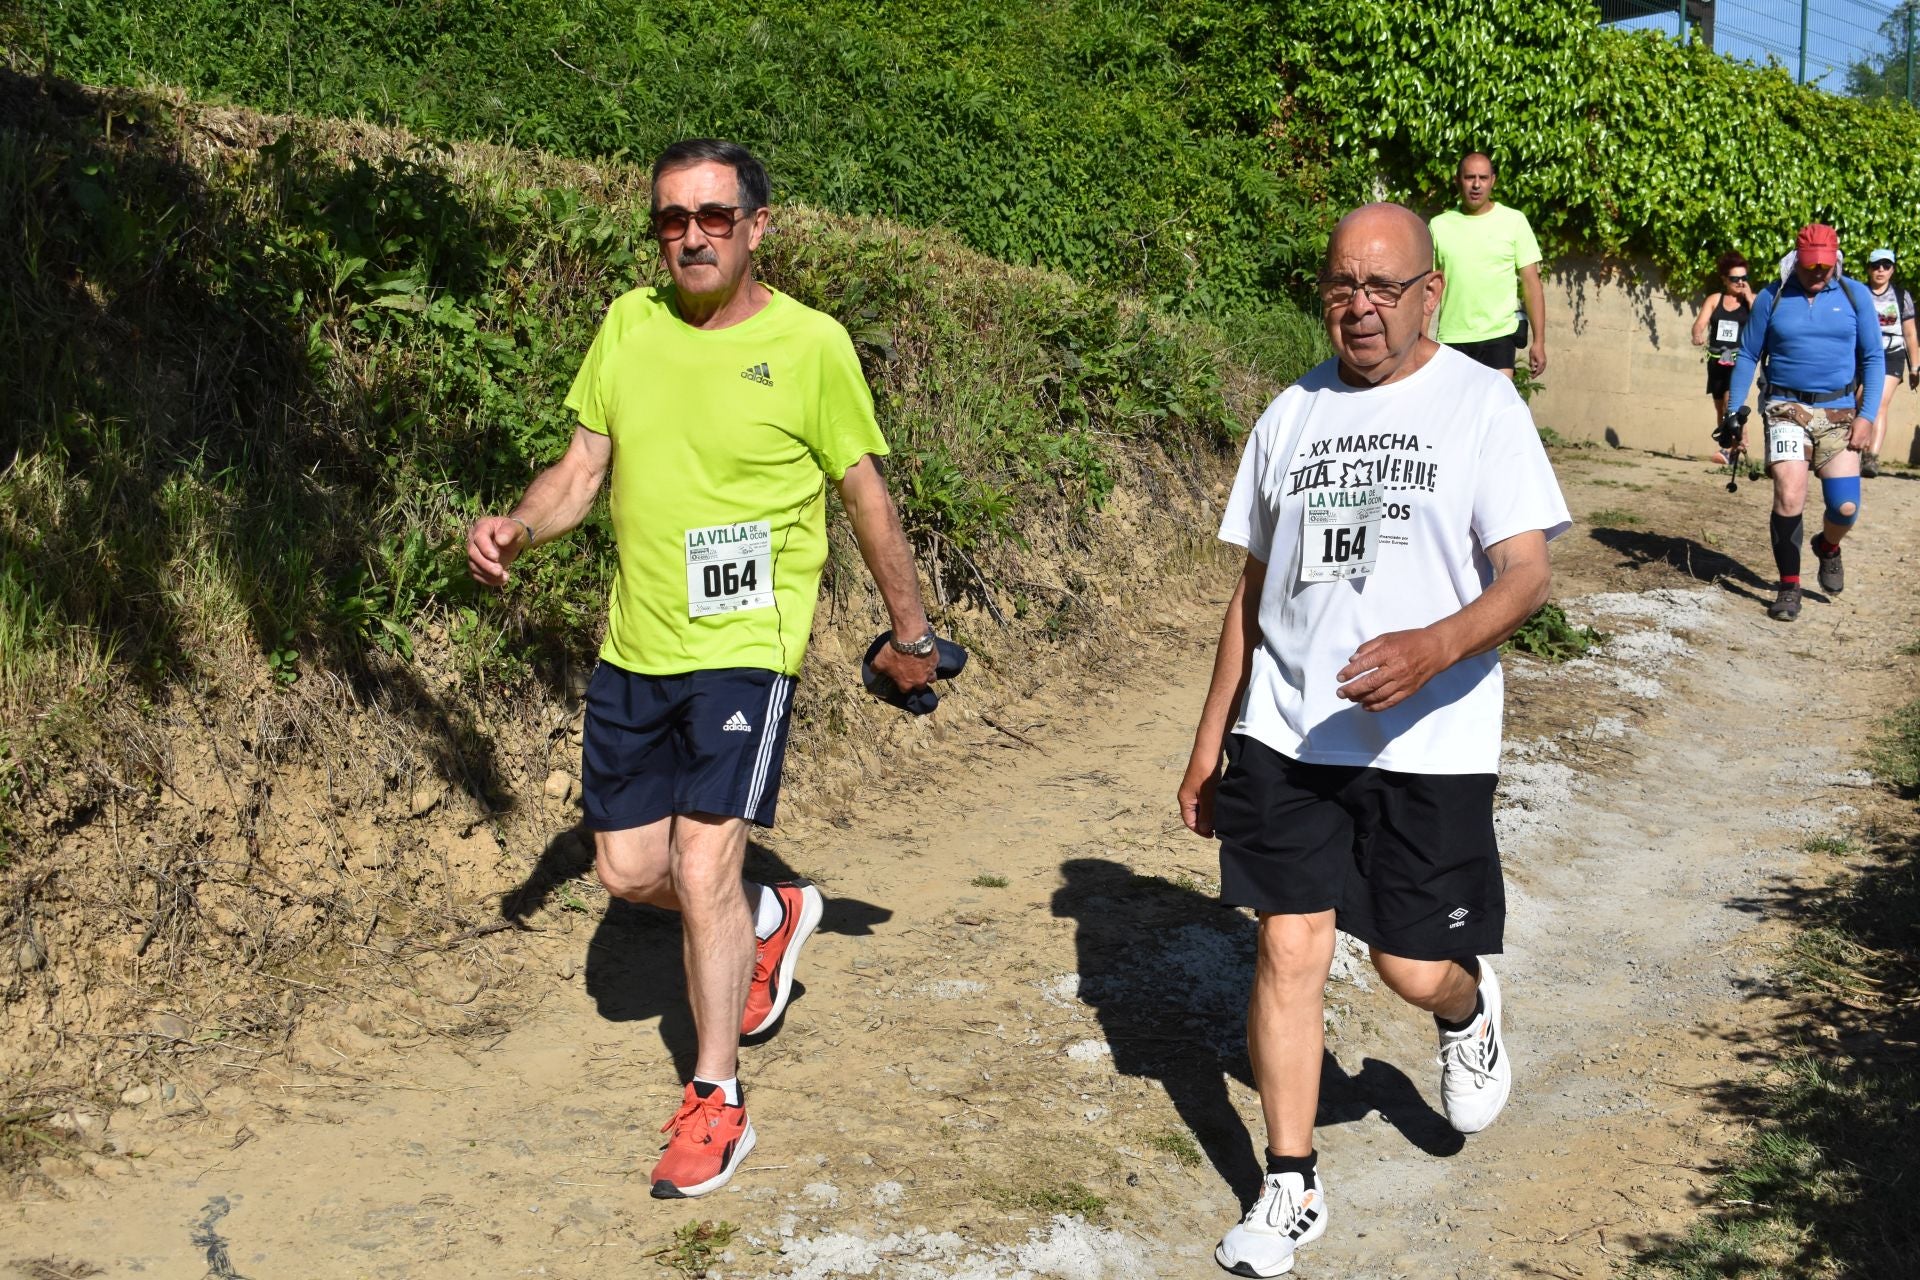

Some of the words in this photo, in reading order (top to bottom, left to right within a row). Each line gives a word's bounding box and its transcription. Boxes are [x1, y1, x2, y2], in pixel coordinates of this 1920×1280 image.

[1722, 329, 1733, 337] 195
[740, 371, 774, 387] adidas
[1309, 438, 1333, 459] XX
[1335, 433, 1419, 453] MARCHA
[1376, 454, 1438, 488] VERDE
[1308, 492, 1326, 508] LA
[1328, 490, 1367, 508] VILLA
[1368, 489, 1376, 497] DE
[688, 531, 706, 548] LA
[707, 526, 749, 545] VILLA
[749, 525, 758, 533] DE
[1322, 525, 1367, 563] 164
[703, 559, 758, 598] 064
[722, 724, 752, 733] adidas
